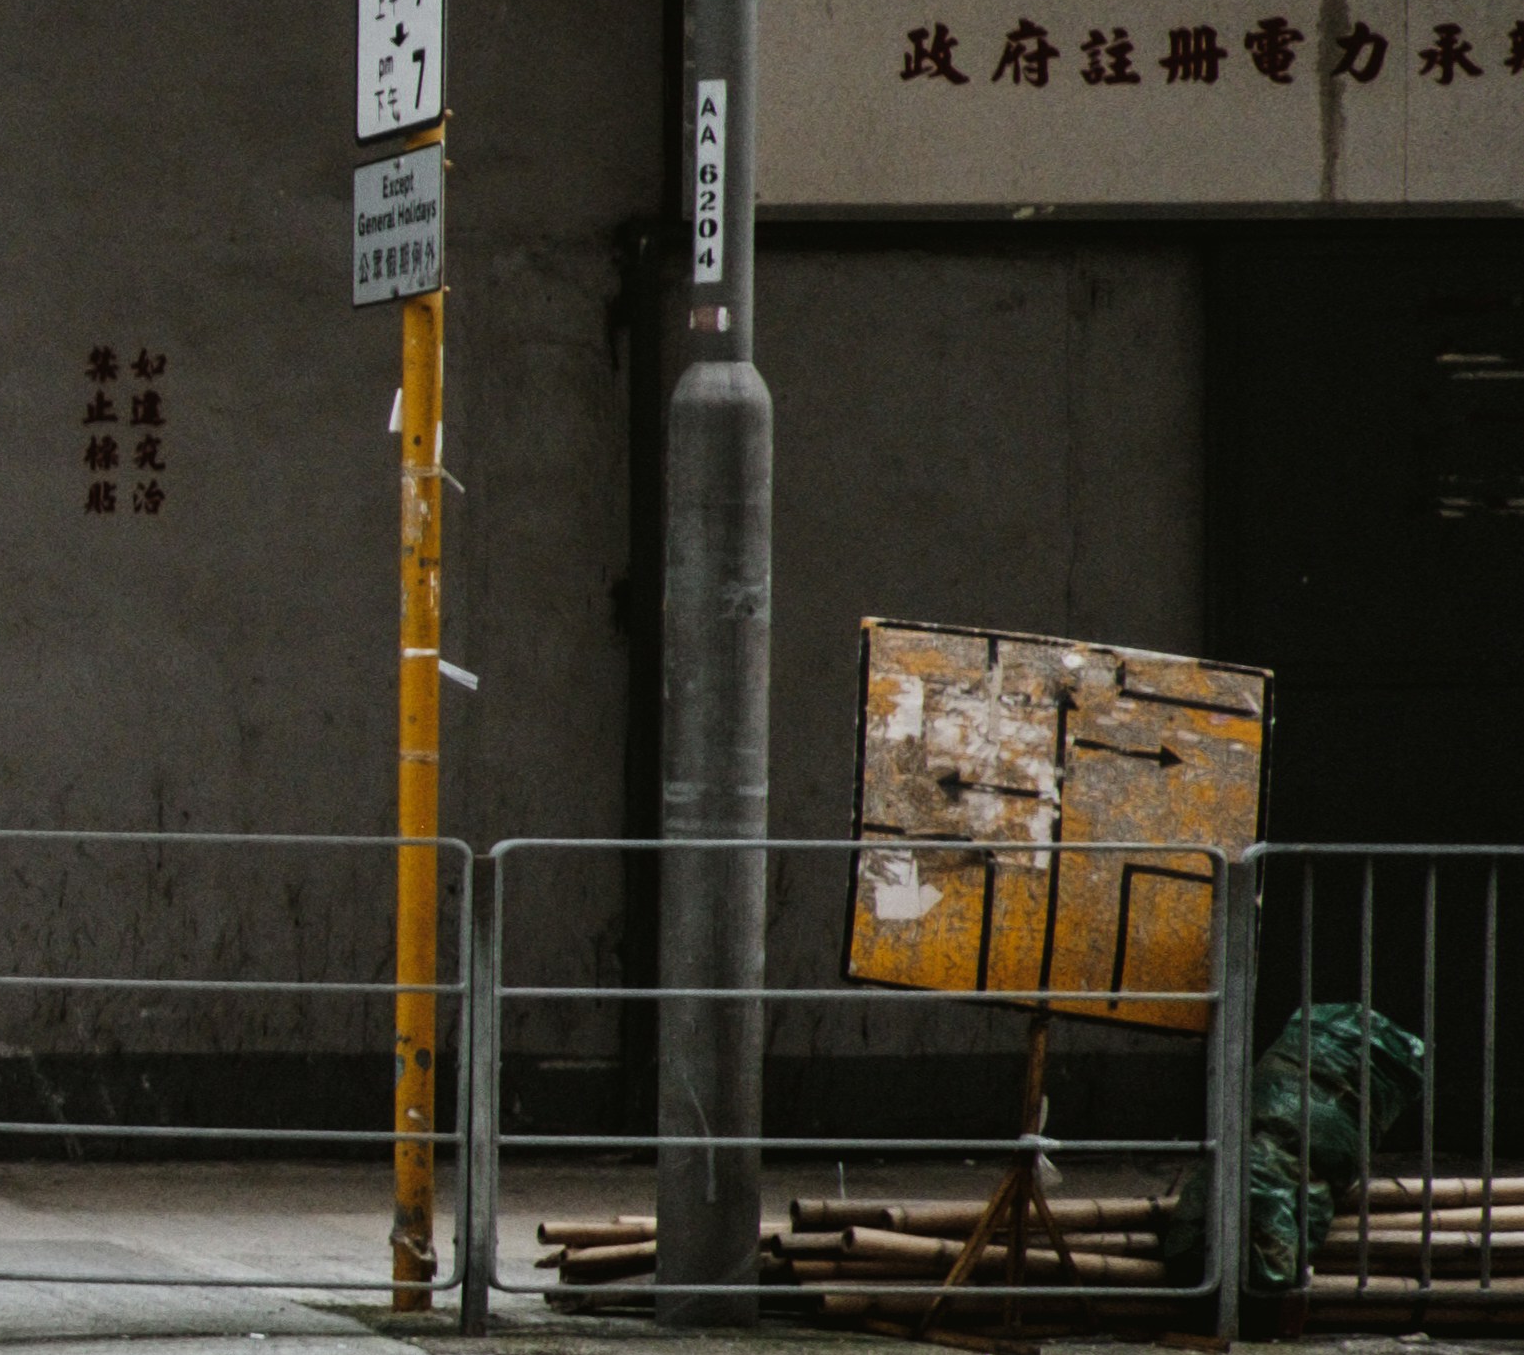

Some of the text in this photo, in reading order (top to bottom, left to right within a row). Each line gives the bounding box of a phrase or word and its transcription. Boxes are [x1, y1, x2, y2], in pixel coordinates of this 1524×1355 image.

[378, 47, 426, 110] pm 7
[381, 170, 415, 200] Except
[698, 96, 718, 270] AA 6204
[358, 198, 437, 237] General Holidays
